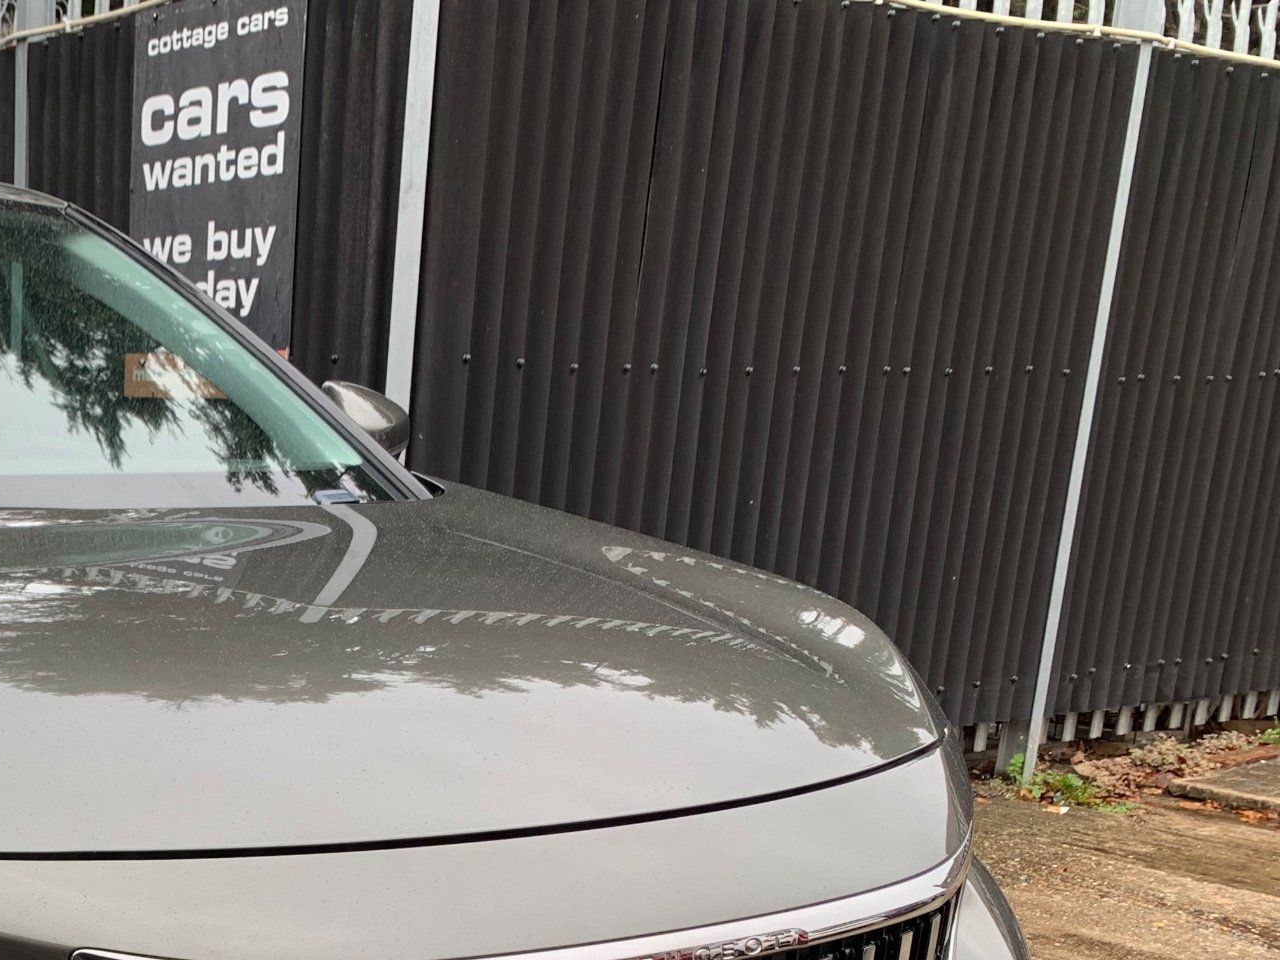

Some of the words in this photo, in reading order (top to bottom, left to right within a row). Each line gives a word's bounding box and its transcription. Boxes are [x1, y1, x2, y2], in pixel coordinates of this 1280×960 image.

[148, 21, 229, 57] cottage
[237, 6, 289, 36] cars
[141, 71, 290, 146] cars
[143, 131, 285, 191] wanted
[143, 233, 192, 264] we
[207, 221, 276, 266] buy
